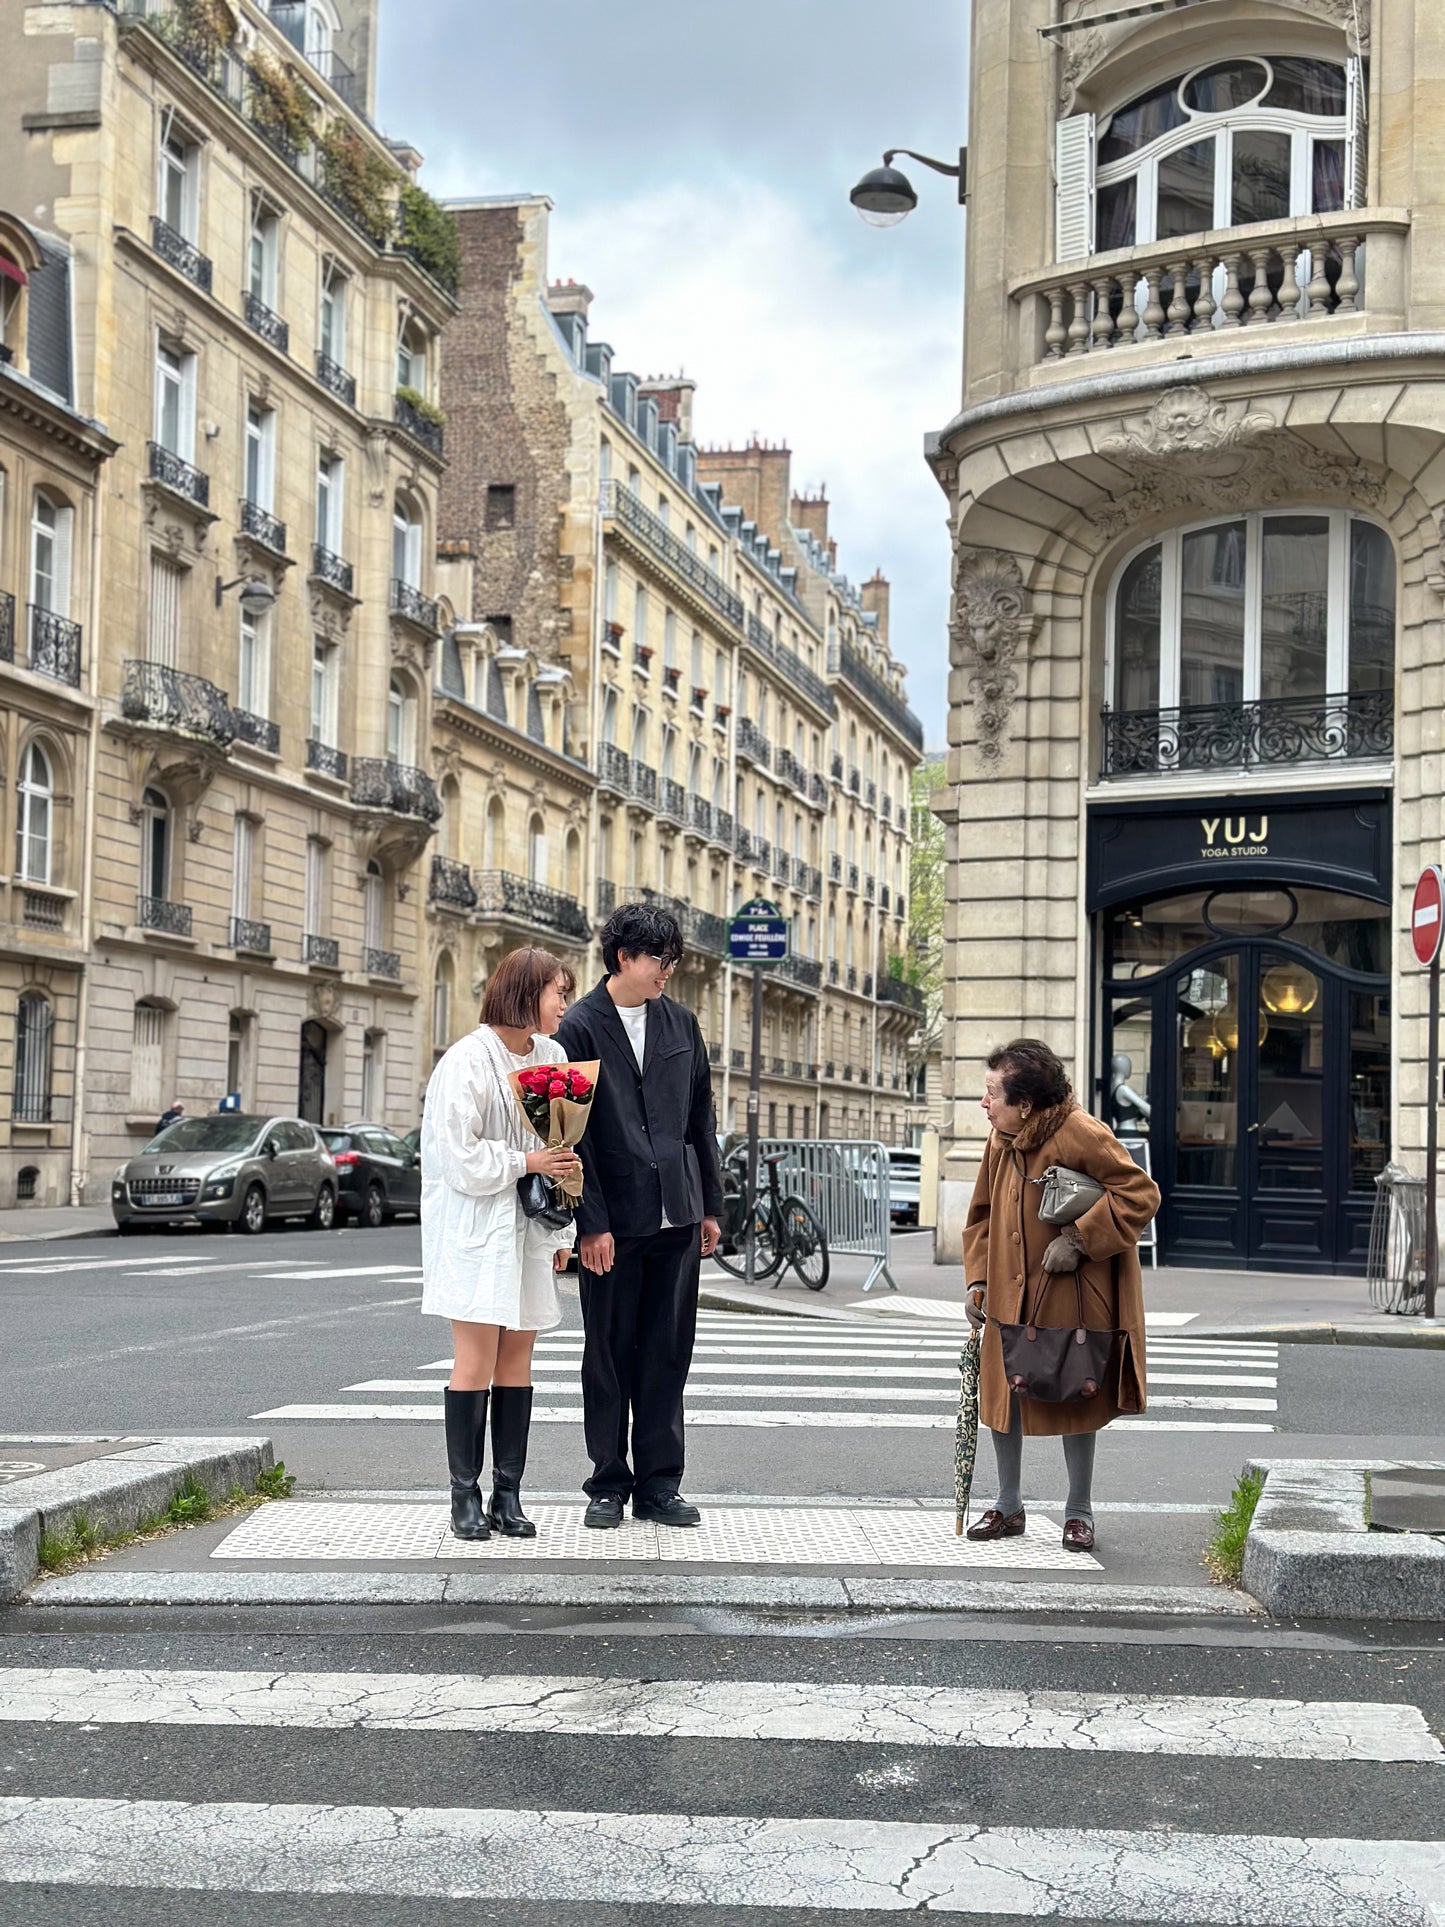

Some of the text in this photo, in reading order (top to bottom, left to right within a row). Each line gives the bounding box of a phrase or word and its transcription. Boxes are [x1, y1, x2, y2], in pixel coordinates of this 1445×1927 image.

[1201, 816, 1268, 845] YUJ
[1201, 846, 1268, 858] YOGA STUDIO
[748, 924, 769, 932] PLACE
